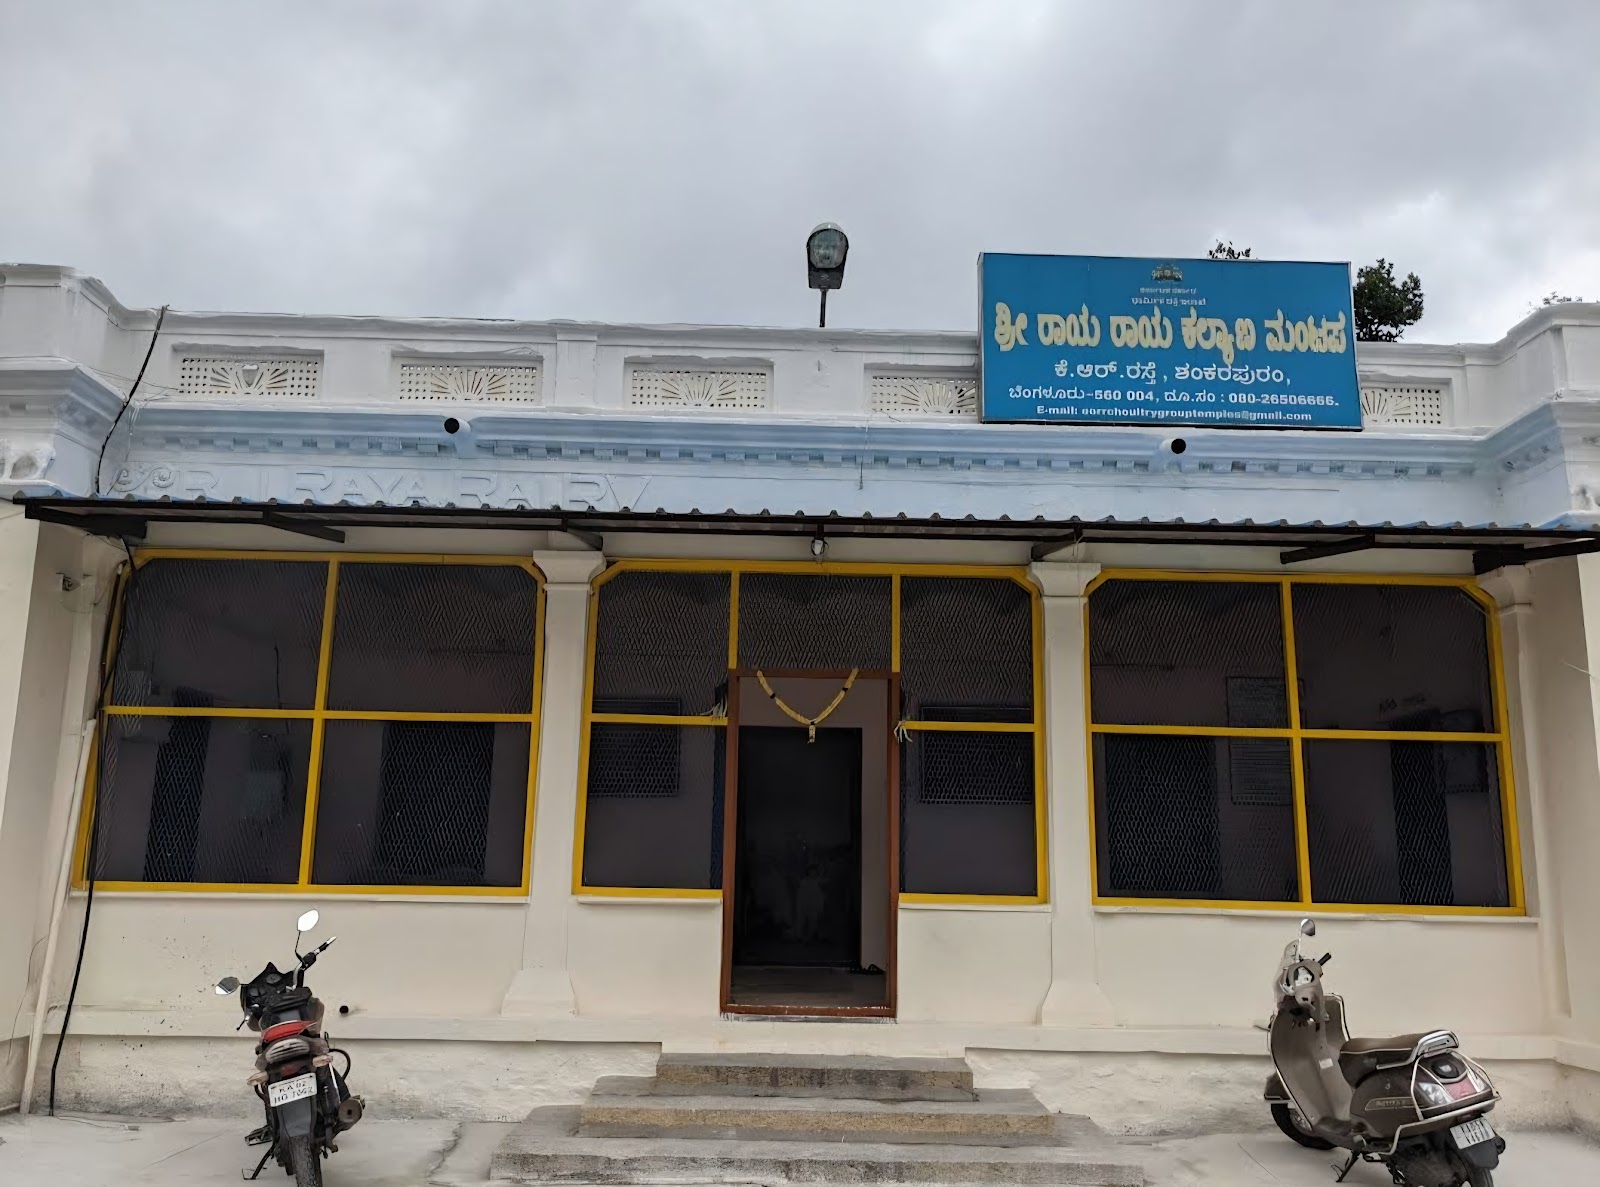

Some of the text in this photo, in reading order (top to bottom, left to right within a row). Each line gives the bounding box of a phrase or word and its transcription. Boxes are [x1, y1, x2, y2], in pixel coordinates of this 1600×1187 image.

[995, 302, 1028, 351] ಶ್ರೀ
[1037, 303, 1101, 347] ರಾಯ
[1110, 306, 1173, 349] ರಾಯ
[1181, 307, 1256, 365] ಕಲ್ಯಾಣ
